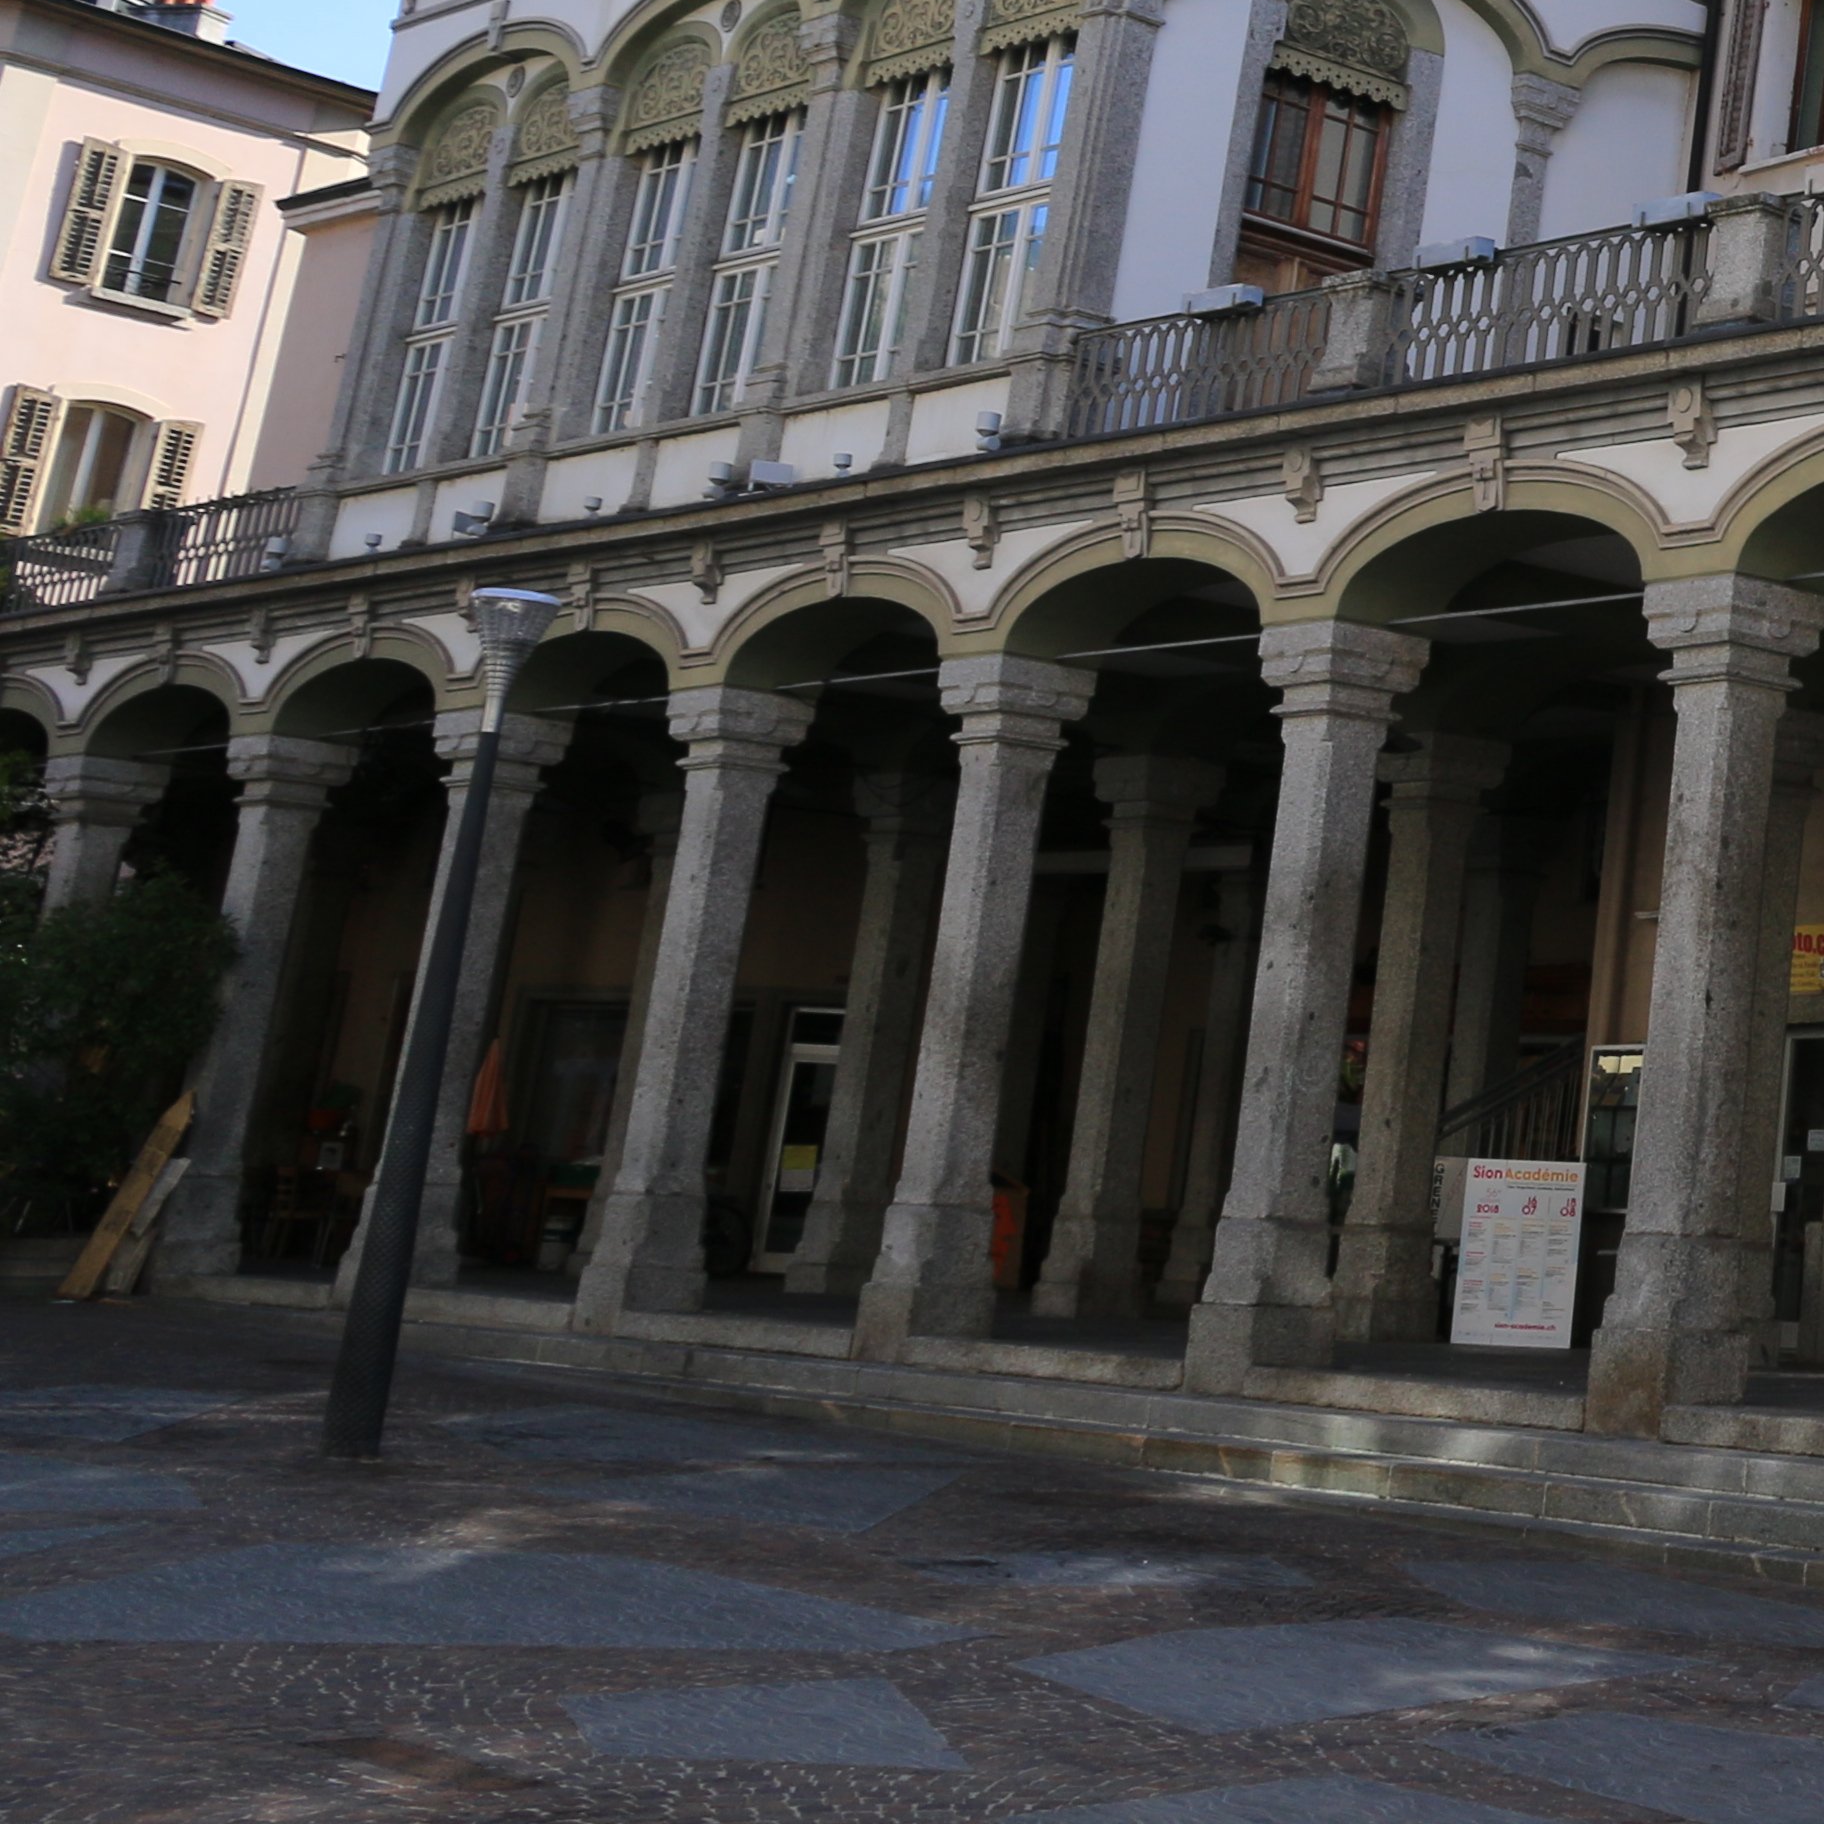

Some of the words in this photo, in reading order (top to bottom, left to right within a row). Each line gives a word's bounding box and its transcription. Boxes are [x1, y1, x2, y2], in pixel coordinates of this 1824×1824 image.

[1473, 1164, 1503, 1179] Sion
[1504, 1167, 1579, 1182] Académie
[1521, 1205, 1538, 1216] 07
